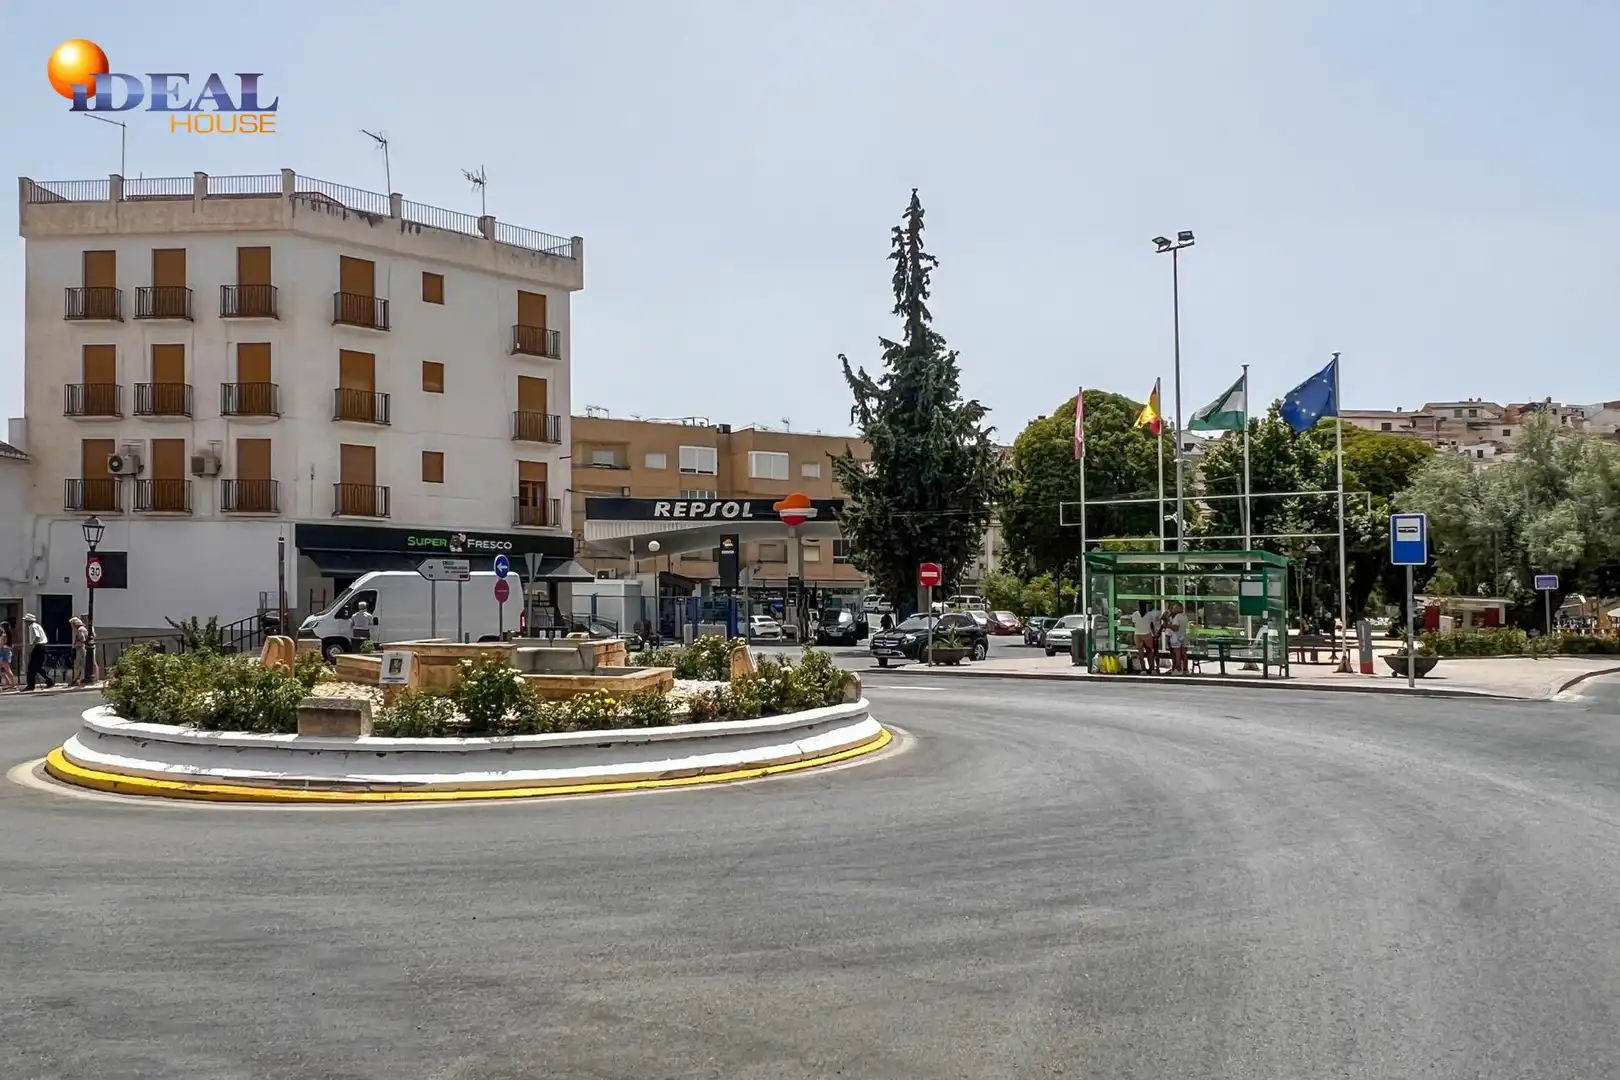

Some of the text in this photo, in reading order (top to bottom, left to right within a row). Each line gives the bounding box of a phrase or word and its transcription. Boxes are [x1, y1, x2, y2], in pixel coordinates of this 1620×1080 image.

[653, 501, 753, 518] REPSOL
[407, 536, 513, 550] SUPER FRESCO
[90, 566, 100, 577] 30
